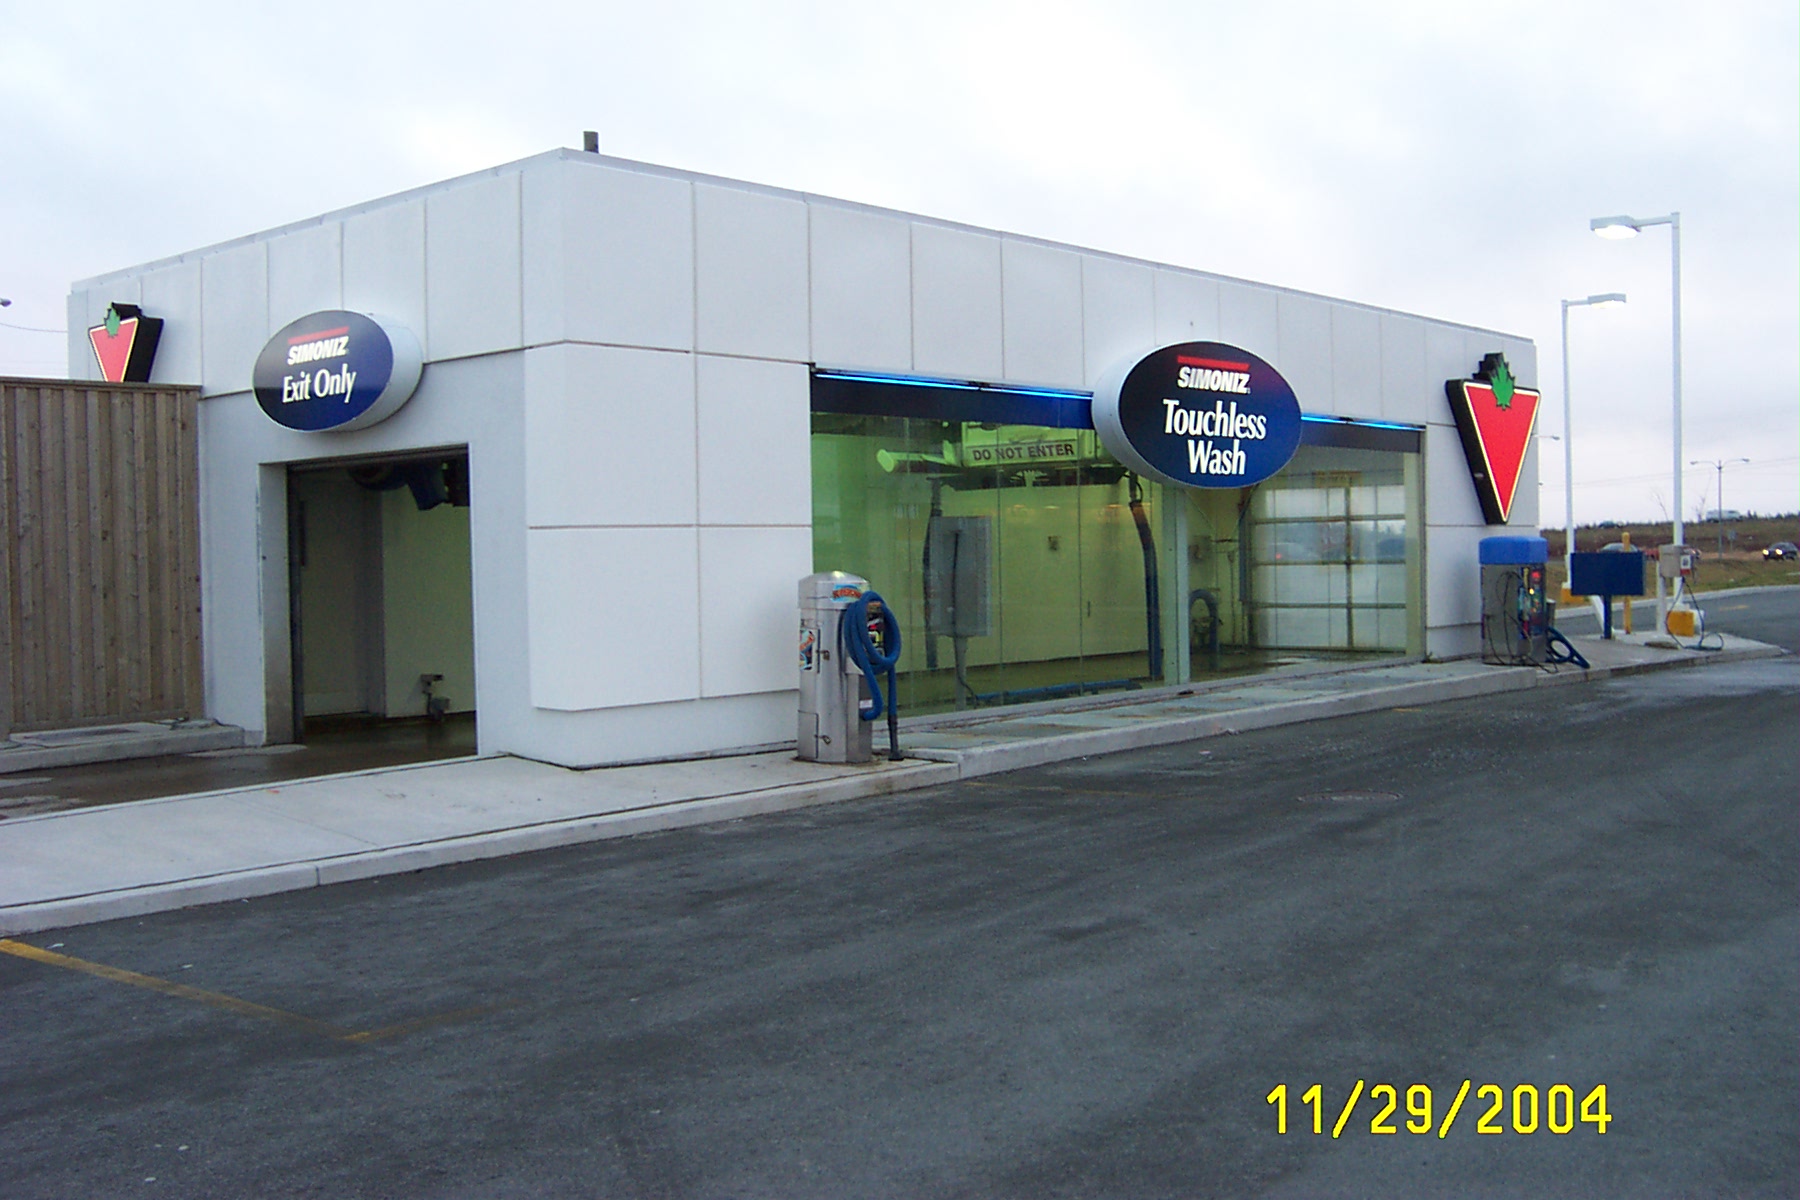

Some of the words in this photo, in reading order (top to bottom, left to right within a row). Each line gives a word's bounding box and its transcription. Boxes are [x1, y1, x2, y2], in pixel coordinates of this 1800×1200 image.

[287, 335, 349, 366] SIMONIZ
[282, 371, 311, 403] Exit
[314, 363, 357, 403] Only
[1177, 366, 1250, 394] SIMONIZ
[1163, 398, 1267, 440] Touchless
[972, 449, 991, 461] DO
[995, 447, 1022, 460] NOT
[1027, 443, 1075, 458] ENTER
[1187, 439, 1246, 475] Wash
